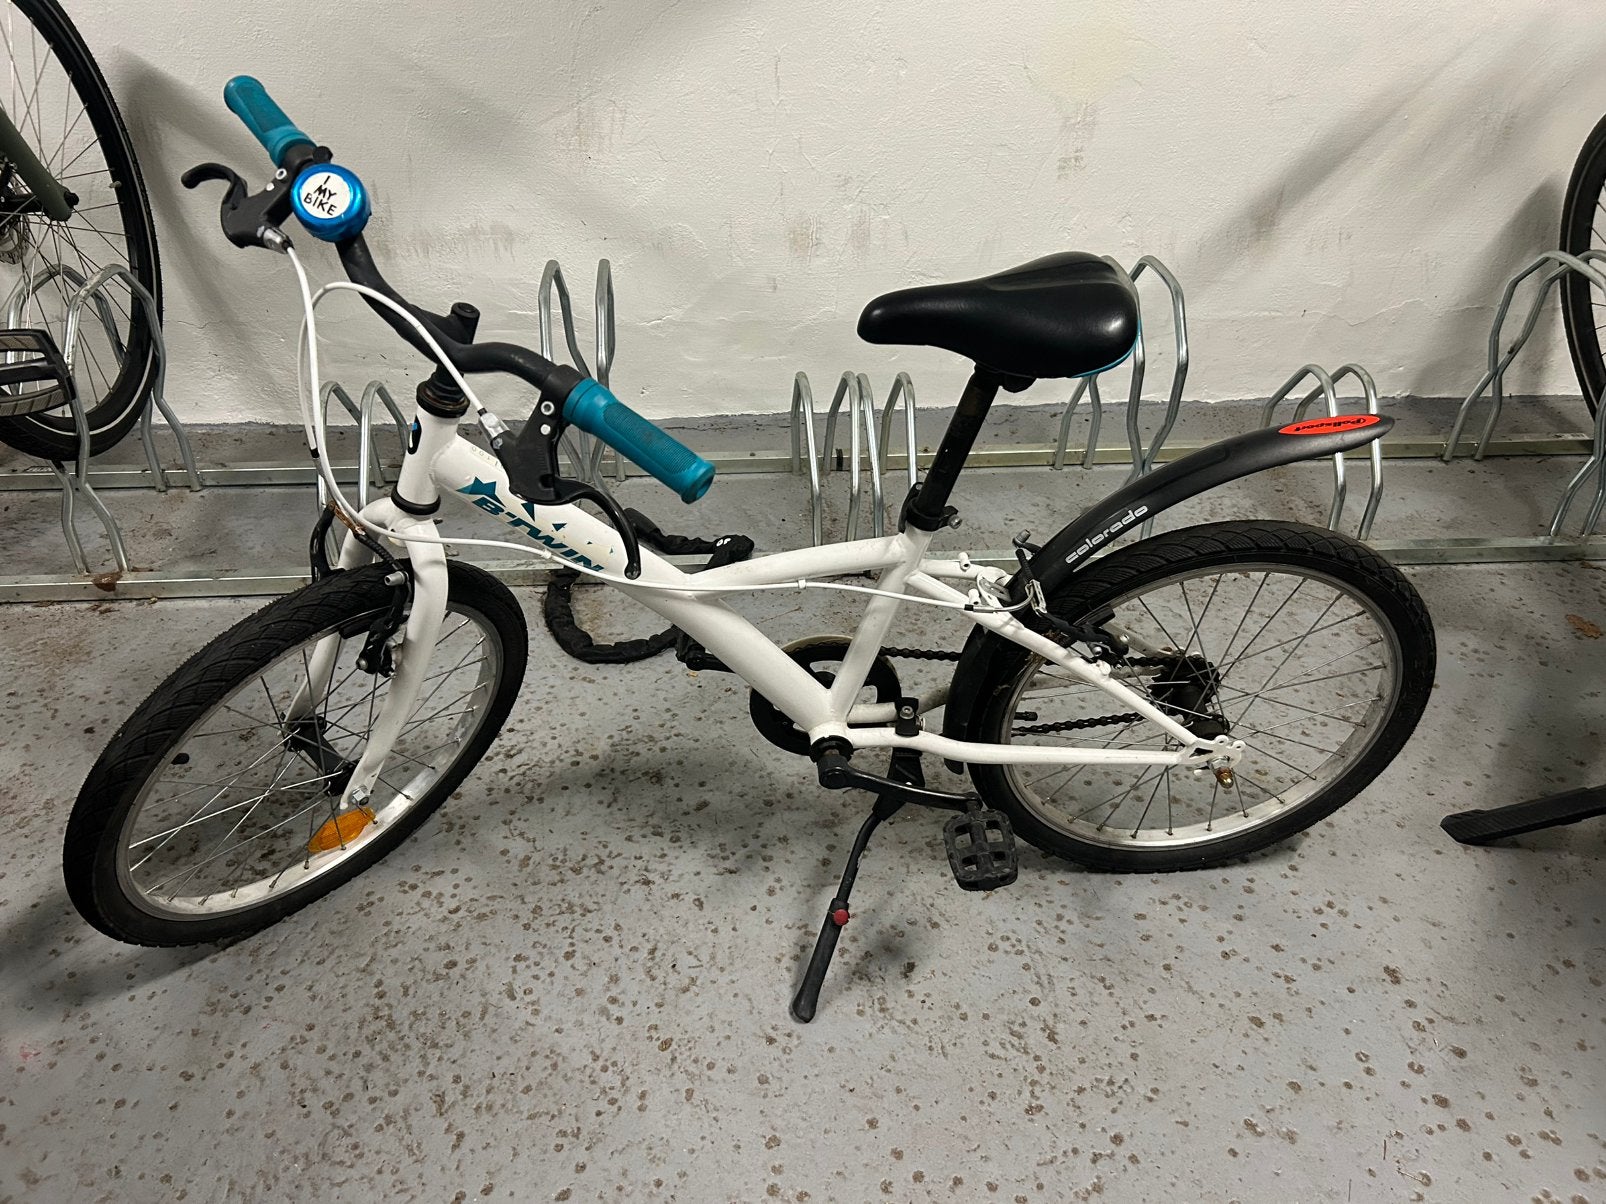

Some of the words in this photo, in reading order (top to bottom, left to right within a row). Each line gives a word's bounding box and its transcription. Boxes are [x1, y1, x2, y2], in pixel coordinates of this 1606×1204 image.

[303, 192, 338, 216] BIKE
[313, 184, 337, 201] MY
[1065, 505, 1149, 564] colorado
